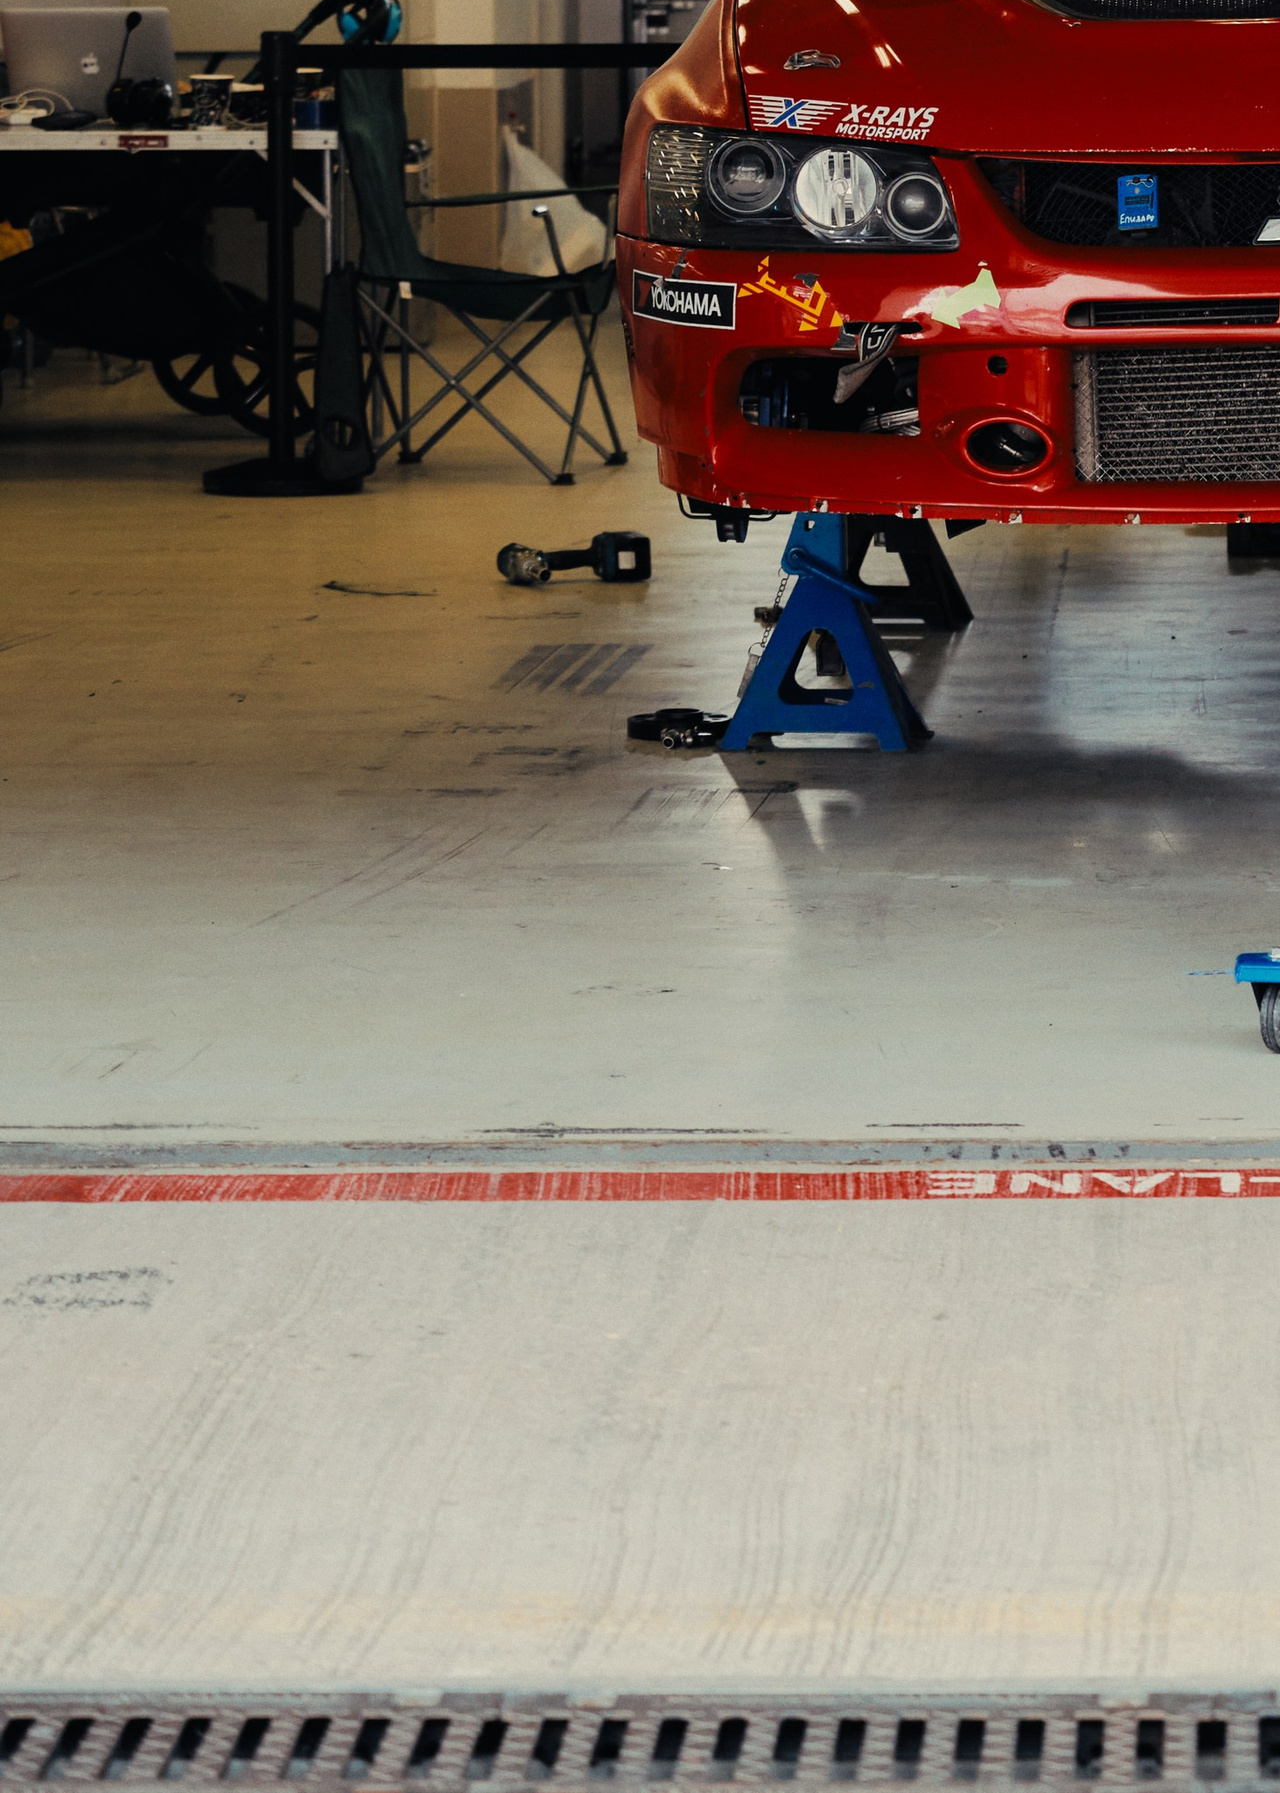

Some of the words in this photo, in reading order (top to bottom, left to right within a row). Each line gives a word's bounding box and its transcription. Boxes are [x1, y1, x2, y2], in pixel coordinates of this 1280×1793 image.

[841, 103, 940, 129] X-RAYS
[835, 122, 930, 141] MOTORSPORT
[651, 286, 722, 317] YOKOHAMA
